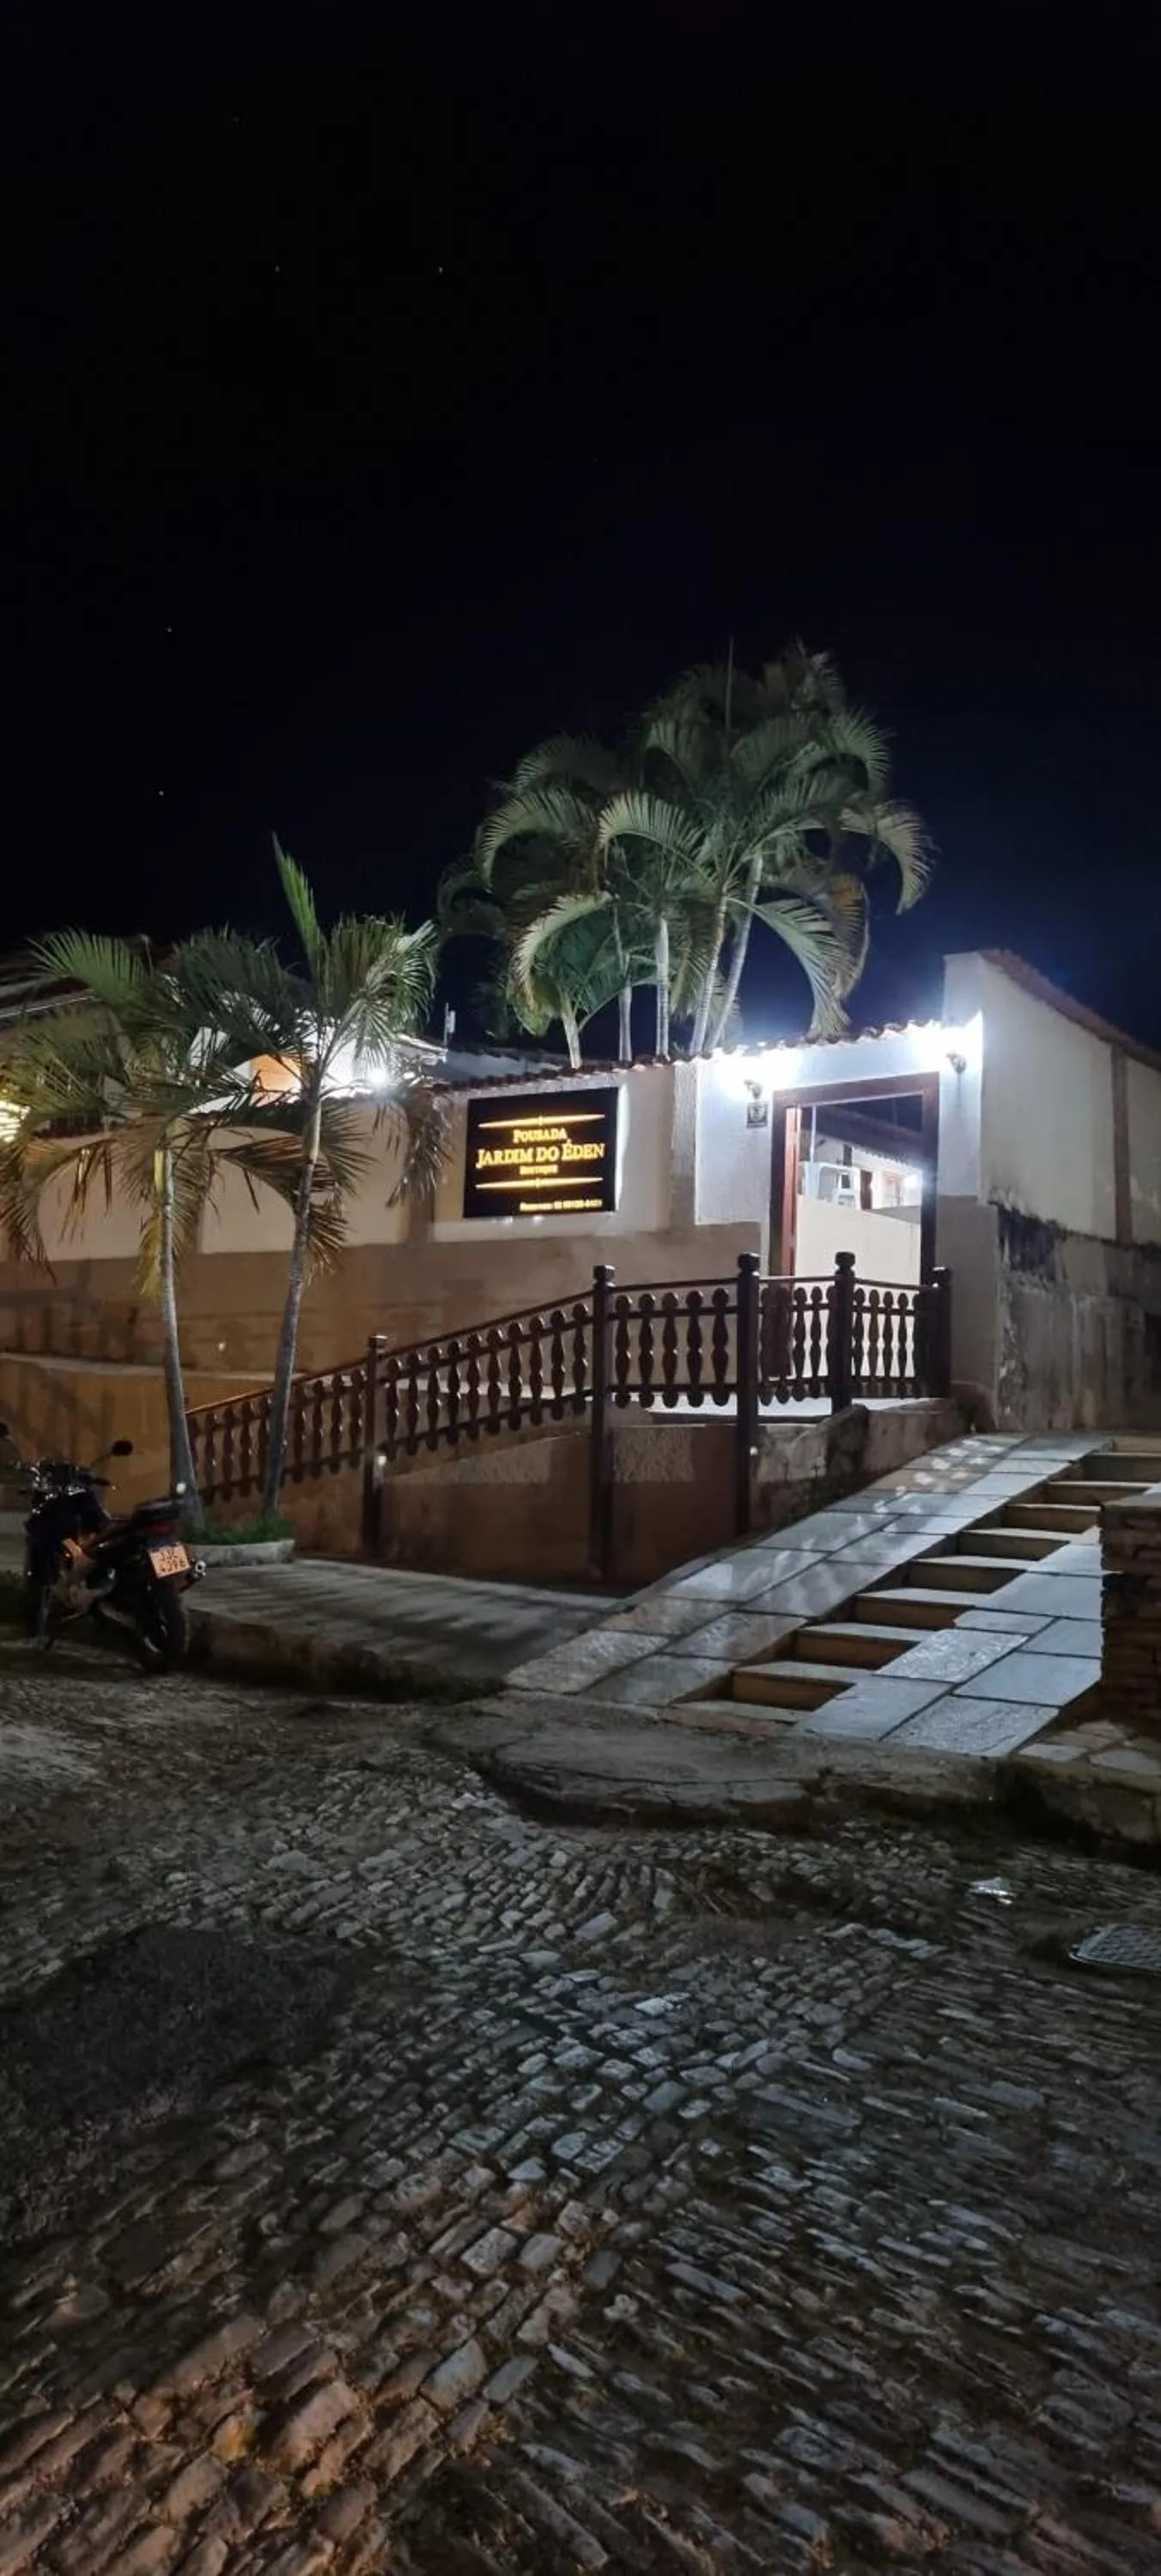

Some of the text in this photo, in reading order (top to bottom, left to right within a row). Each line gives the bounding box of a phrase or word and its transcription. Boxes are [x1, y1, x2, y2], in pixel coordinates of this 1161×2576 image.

[513, 1127, 568, 1143] POUSADA
[476, 1139, 605, 1169] JARDIM DO ÉDEN
